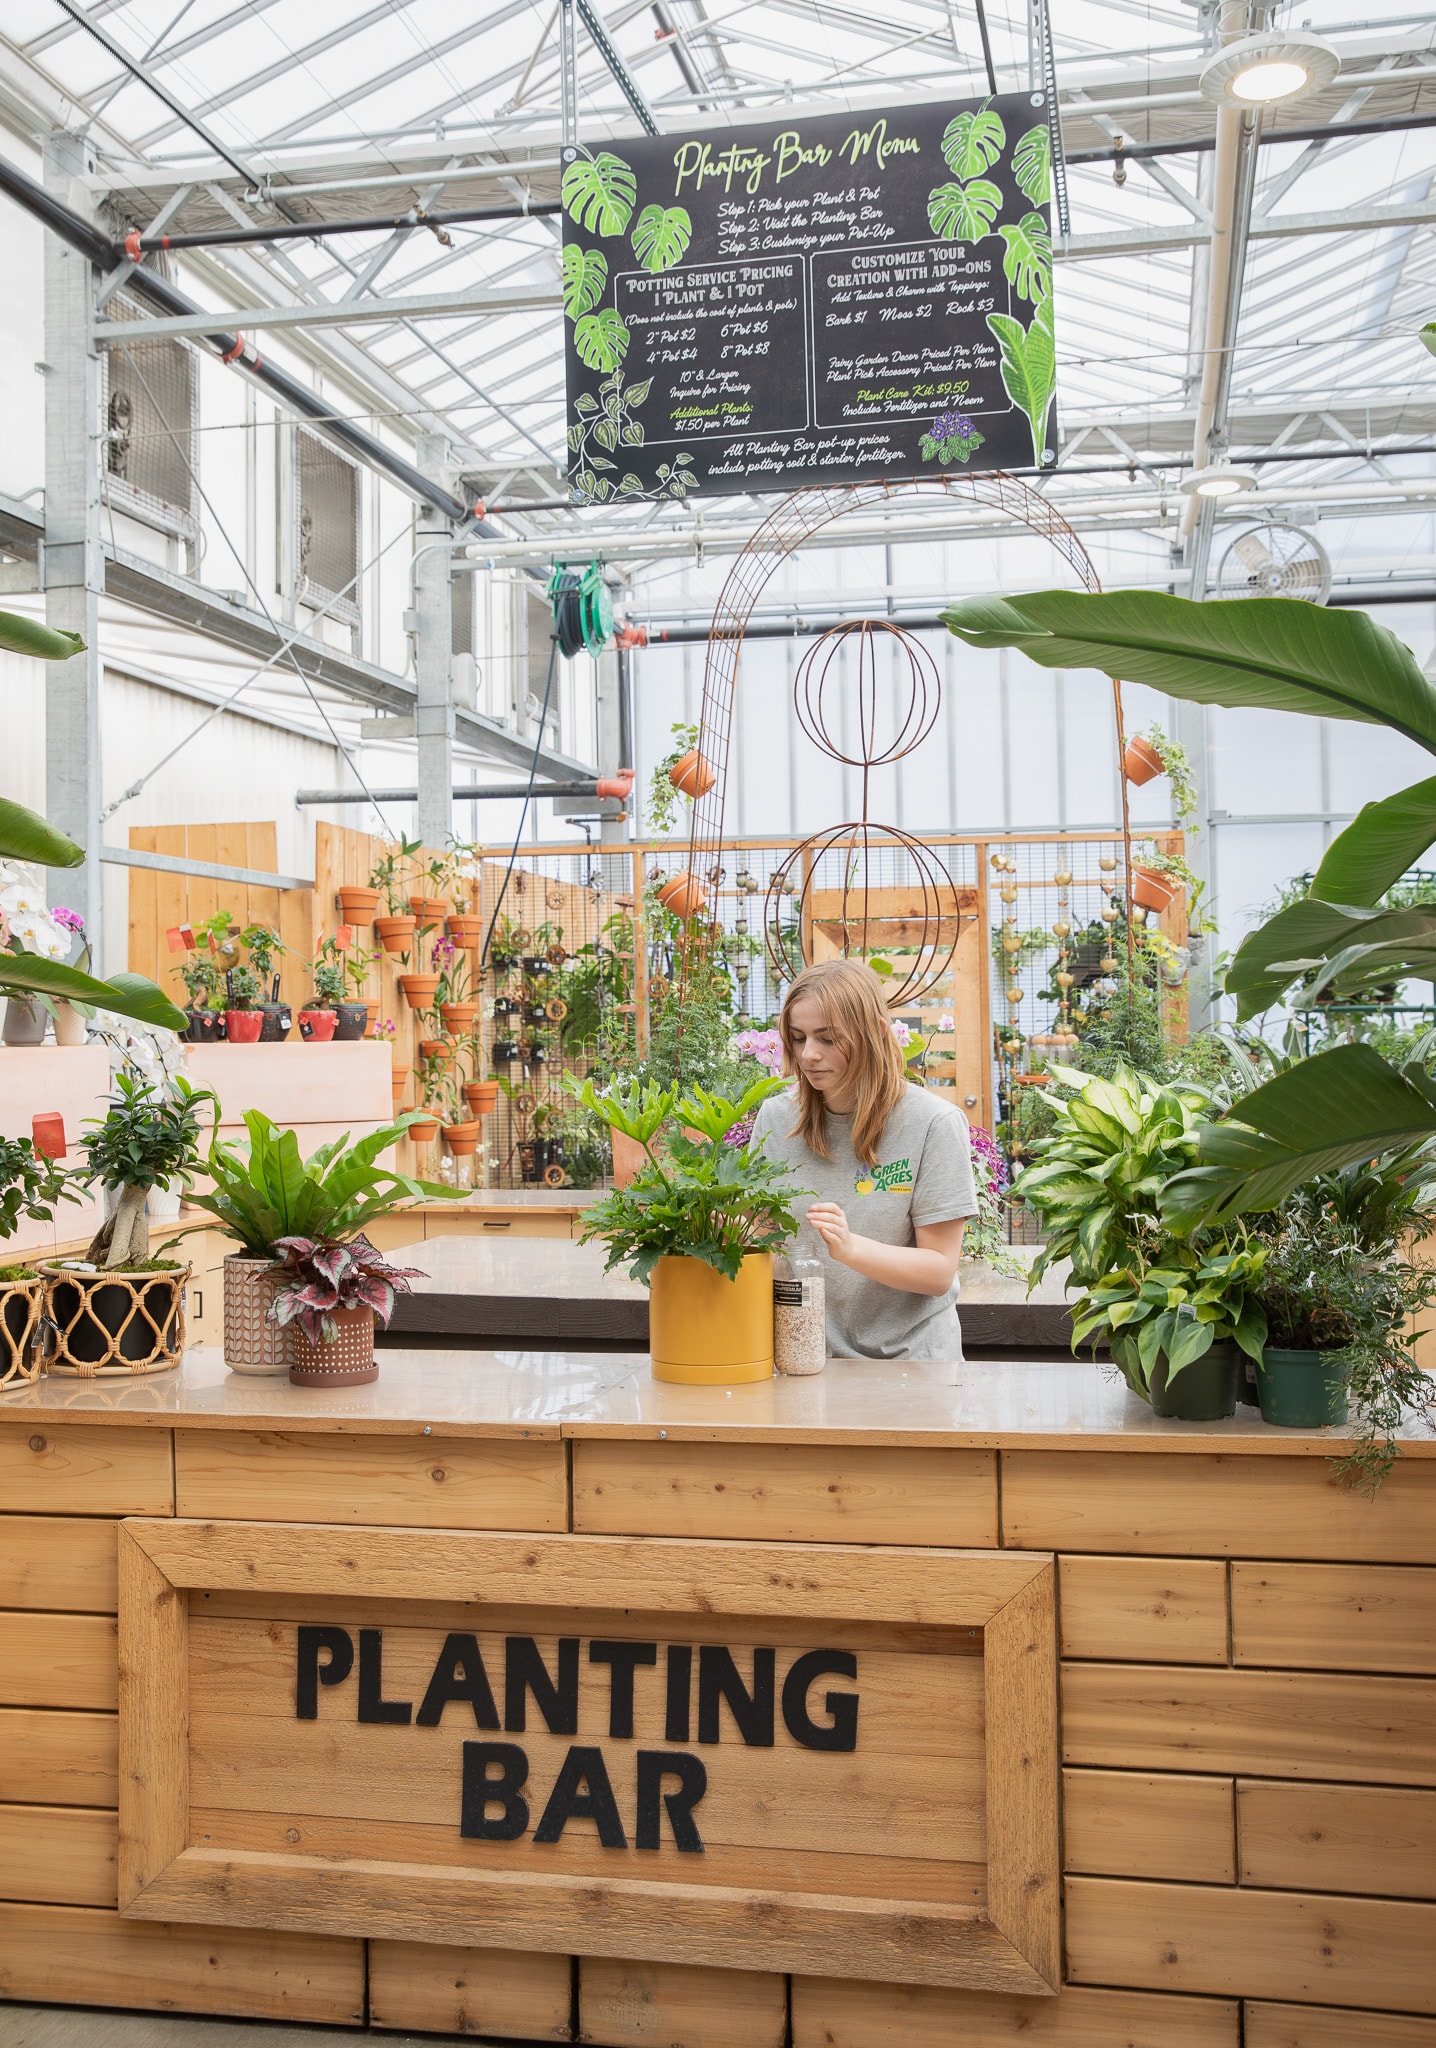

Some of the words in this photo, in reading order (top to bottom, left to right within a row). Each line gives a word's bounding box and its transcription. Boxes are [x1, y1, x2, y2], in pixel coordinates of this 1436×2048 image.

[674, 141, 771, 196] Planting
[773, 131, 832, 183] Bar
[839, 118, 919, 170] Menu
[717, 203, 745, 219] Step
[747, 201, 755, 214] 1:
[758, 197, 782, 212] Pick
[784, 199, 809, 213] your
[813, 192, 844, 207] Plant
[846, 189, 855, 201] &
[859, 186, 881, 201] Pot
[718, 222, 746, 238] Step
[748, 219, 759, 232] 2:
[763, 216, 789, 230] Visit
[791, 214, 807, 227] the
[811, 209, 857, 225] Planting
[861, 206, 883, 220] Bar
[718, 240, 746, 256] Step
[748, 237, 760, 251] 3:
[762, 234, 818, 249] Customize
[820, 233, 845, 247] your
[848, 223, 895, 241] Pot-Up
[852, 251, 925, 269] CUSTOMIZE
[929, 247, 965, 261] YOUR
[626, 277, 683, 292] POTTING
[687, 271, 736, 287] SERVICE
[740, 265, 793, 280] PRICING
[827, 271, 890, 288] CREATION
[894, 266, 927, 281] WITH
[932, 260, 991, 278] ADD-ONS
[655, 293, 659, 306] 1
[663, 290, 705, 305] PLANT
[710, 287, 724, 300] &
[728, 285, 732, 298] 1
[736, 284, 764, 297] POT
[831, 292, 851, 304] Add
[854, 289, 884, 301] Texture
[886, 287, 893, 297] &
[896, 285, 925, 297] Charm
[927, 282, 946, 293] with
[948, 280, 989, 294] Toppings:
[625, 315, 649, 327] (Does
[651, 312, 664, 323] not
[665, 309, 693, 321] include
[696, 307, 707, 318] the
[709, 307, 726, 317] cost
[727, 306, 737, 318] of
[737, 303, 763, 316] plants
[765, 301, 773, 310] &
[774, 298, 797, 313] pots)
[879, 307, 913, 321] Moss
[916, 304, 932, 318] $2
[946, 301, 975, 315] Rock
[977, 298, 995, 311] $3
[752, 320, 768, 333] $6
[825, 313, 851, 327] Bark
[854, 311, 868, 323] $1
[660, 330, 679, 344] Pot
[680, 327, 696, 341] $2
[661, 350, 680, 363] Pot
[681, 347, 697, 360] $4
[734, 344, 753, 357] Pot
[754, 342, 770, 354] $8
[829, 357, 853, 369] Fairy
[855, 353, 889, 368] Garden
[892, 351, 918, 363] Decor
[921, 346, 951, 360] Priced
[953, 345, 970, 357] Per
[973, 343, 995, 355] Item
[696, 369, 704, 380] &
[706, 369, 739, 383] Larger
[826, 370, 851, 382] Plant
[854, 368, 874, 380] Pick
[876, 364, 921, 378] Accessory
[923, 360, 953, 373] Priced
[955, 359, 972, 371] Per
[975, 357, 997, 368] Item
[670, 387, 701, 400] Inquire
[701, 384, 717, 398] for
[719, 381, 751, 394] Pricing
[857, 388, 884, 402] Plant
[886, 387, 909, 399] Care
[912, 385, 934, 397] Kit:
[936, 380, 970, 394] $9.50
[670, 404, 719, 420] Additional
[721, 401, 753, 415] Plants:
[842, 403, 881, 416] Includes
[884, 400, 928, 414] Fertilizer
[930, 396, 948, 408] and
[951, 394, 984, 406] Neem
[675, 418, 703, 431] $1.50
[703, 421, 720, 432] per
[723, 414, 750, 427] Plant
[723, 443, 742, 458] All
[746, 440, 790, 456] Planting
[794, 438, 815, 452] Bar
[816, 435, 856, 453] pot-up
[858, 434, 890, 449] prices
[708, 460, 745, 475] include
[746, 458, 784, 476] potting
[786, 455, 805, 468] soil
[807, 453, 817, 466] &
[819, 451, 854, 465] starter
[855, 448, 906, 467] fertilizer.
[871, 1158, 909, 1179] GREEN
[874, 1170, 912, 1191] ACRES
[296, 1625, 860, 1752] PLANTING
[460, 1740, 705, 1854] BAR
